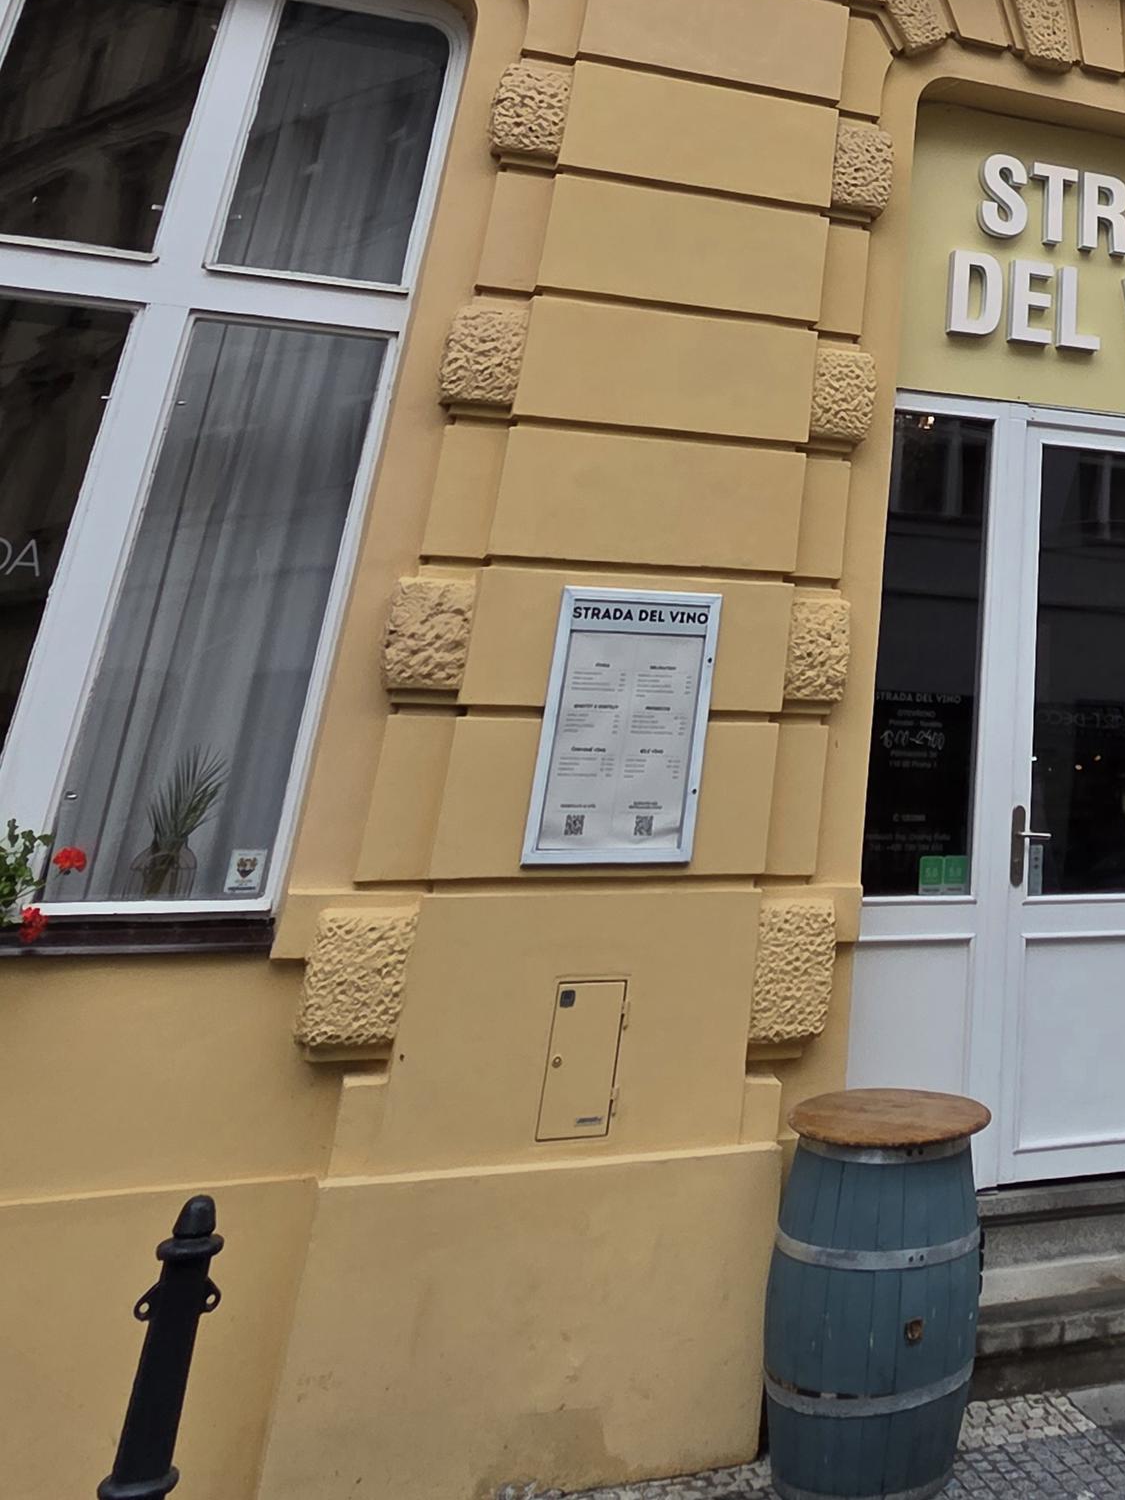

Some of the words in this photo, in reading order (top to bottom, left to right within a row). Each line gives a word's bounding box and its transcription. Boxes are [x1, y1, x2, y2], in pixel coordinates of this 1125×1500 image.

[946, 249, 1100, 353] DEL
[572, 606, 633, 621] STRADA
[638, 609, 666, 622] DEL
[670, 611, 709, 624] VINO
